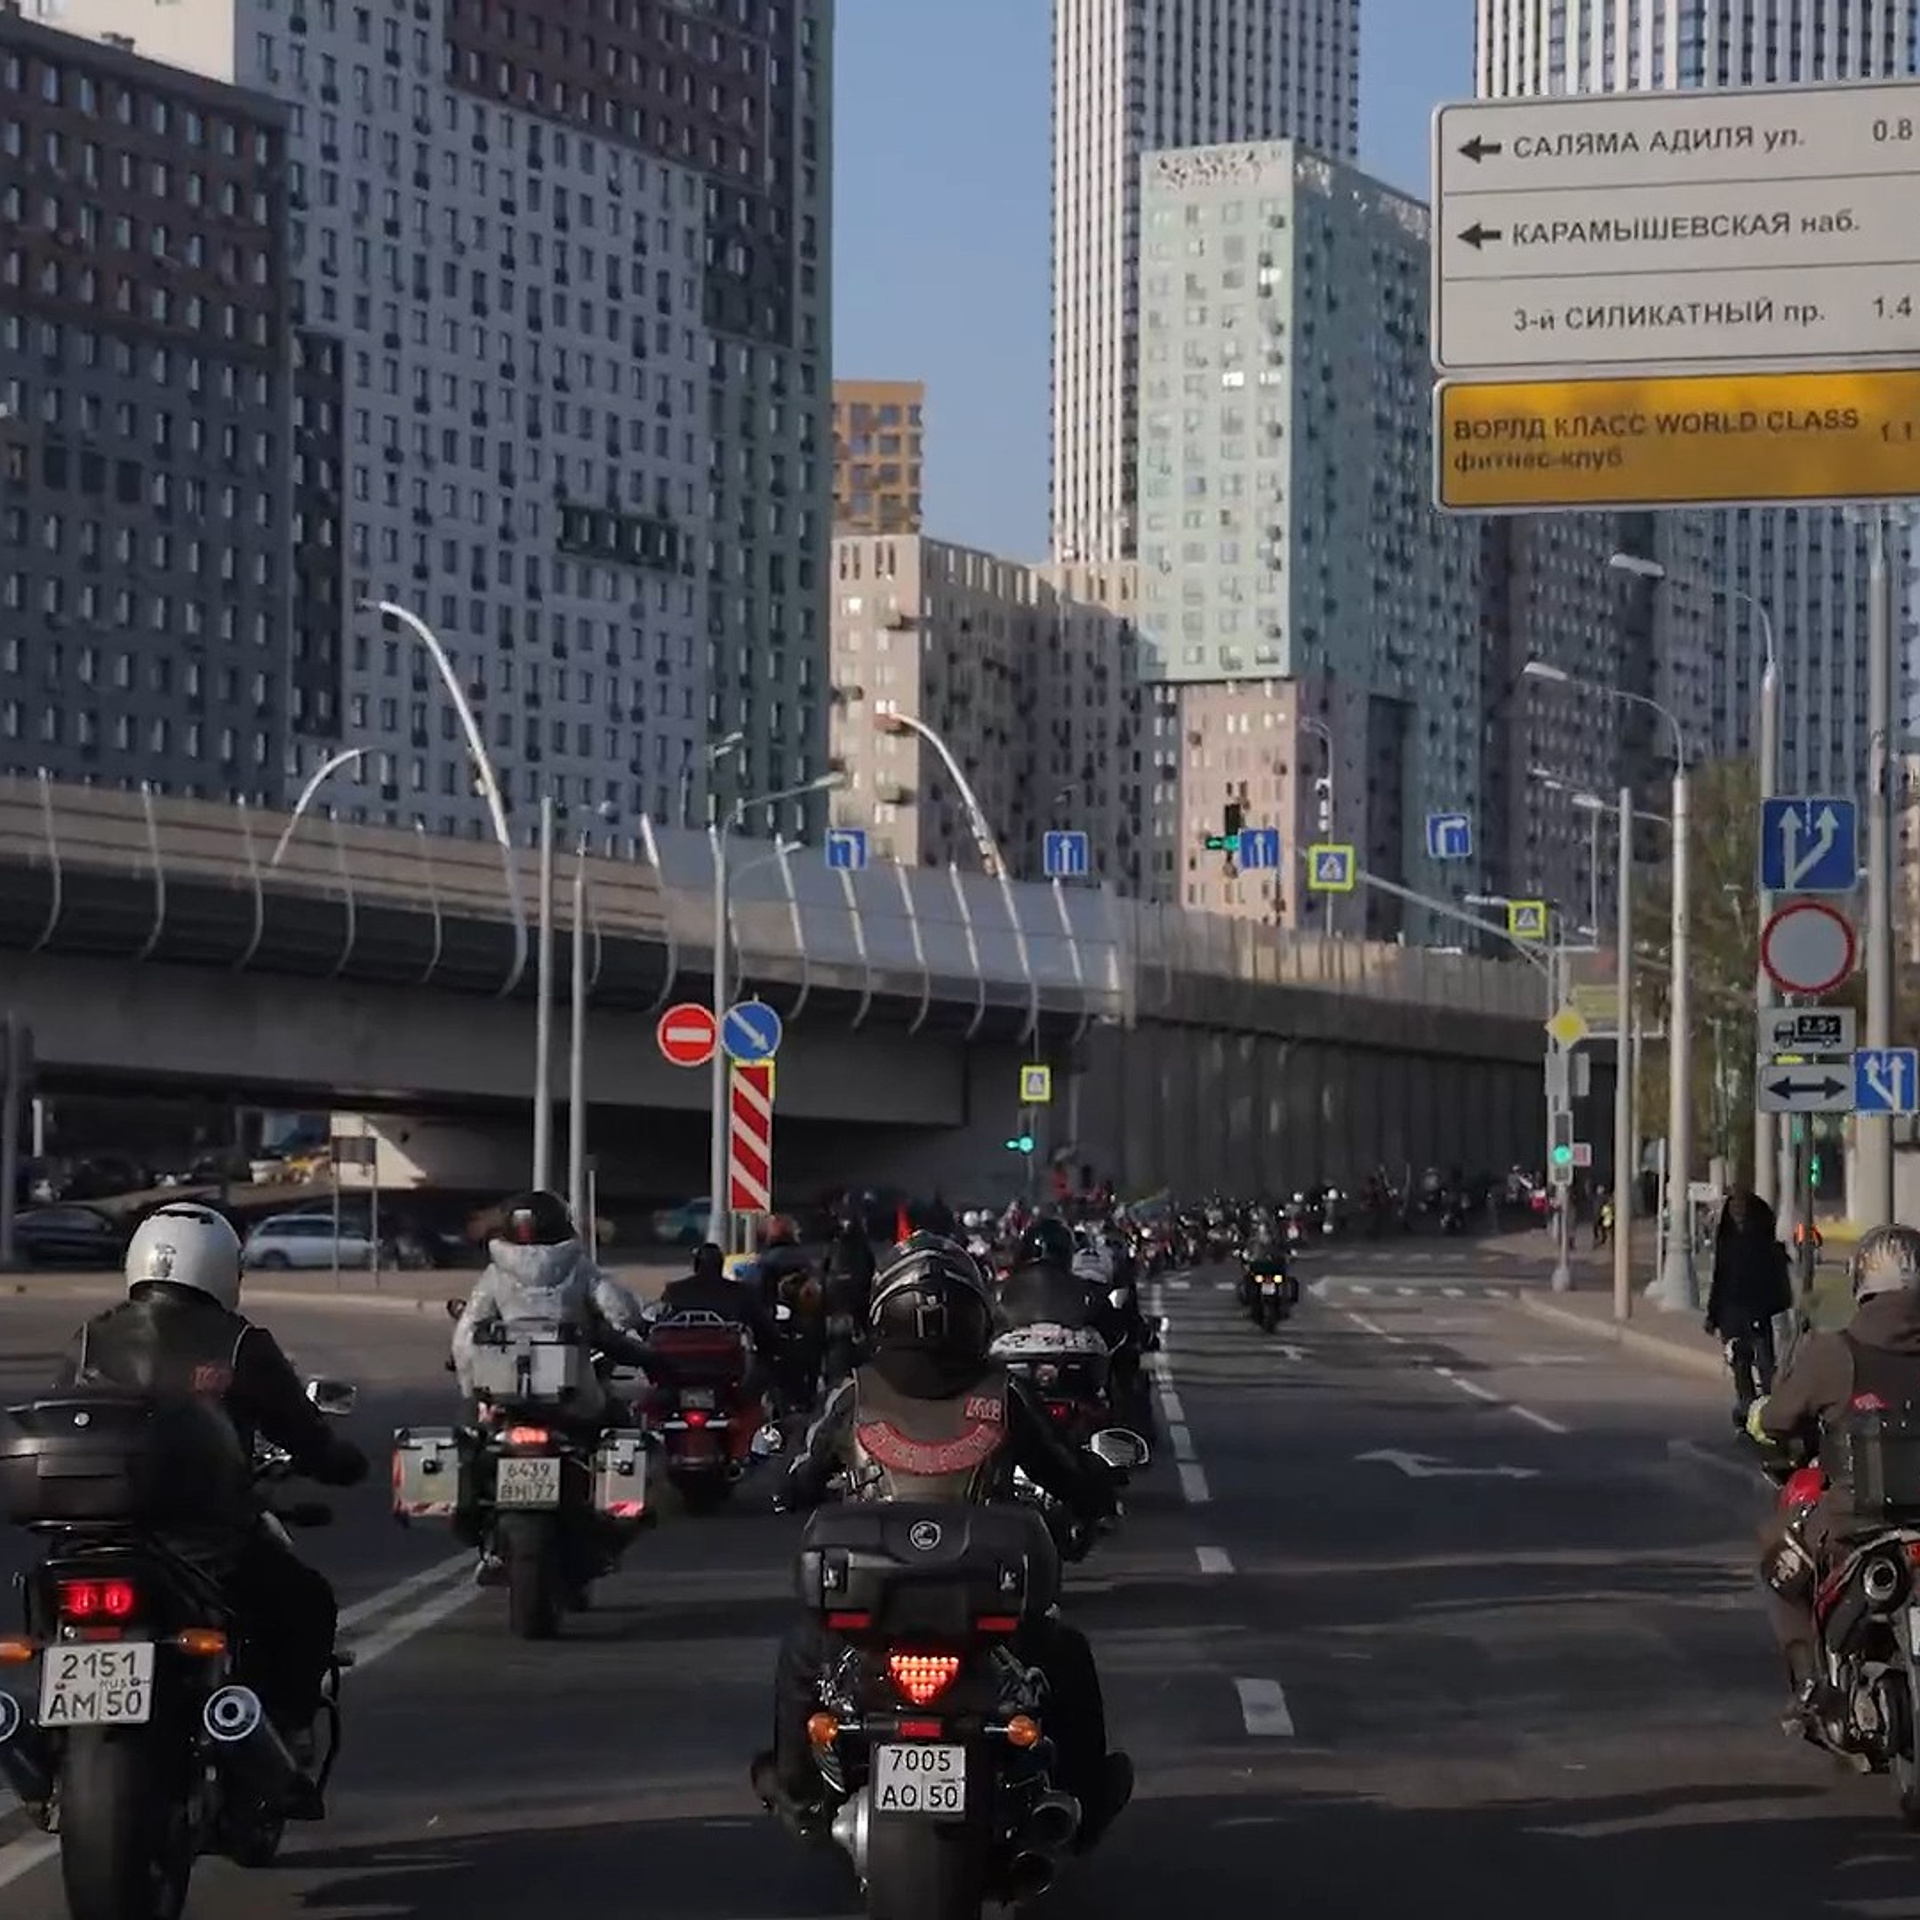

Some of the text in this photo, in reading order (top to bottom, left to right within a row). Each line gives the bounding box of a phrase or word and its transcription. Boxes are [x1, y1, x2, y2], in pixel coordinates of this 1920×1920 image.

[1513, 118, 1914, 159] САЛЯМА АДИЛЯ ул. 0.8
[1512, 208, 1861, 246] КАРАМЫШЕВСКАЯ наб.
[1513, 295, 1913, 332] 3-й СИЛИКАТНЫЙ пр. 1.4
[1454, 417, 1546, 441] ВОРЛД
[1554, 413, 1648, 438] КЛАСС
[1655, 411, 1758, 435] WORLD
[1767, 408, 1860, 434] CLASS
[61, 1650, 136, 1680] 2151
[106, 1689, 142, 1717] 50
[890, 1749, 951, 1772] 7005
[929, 1785, 958, 1808] 50
